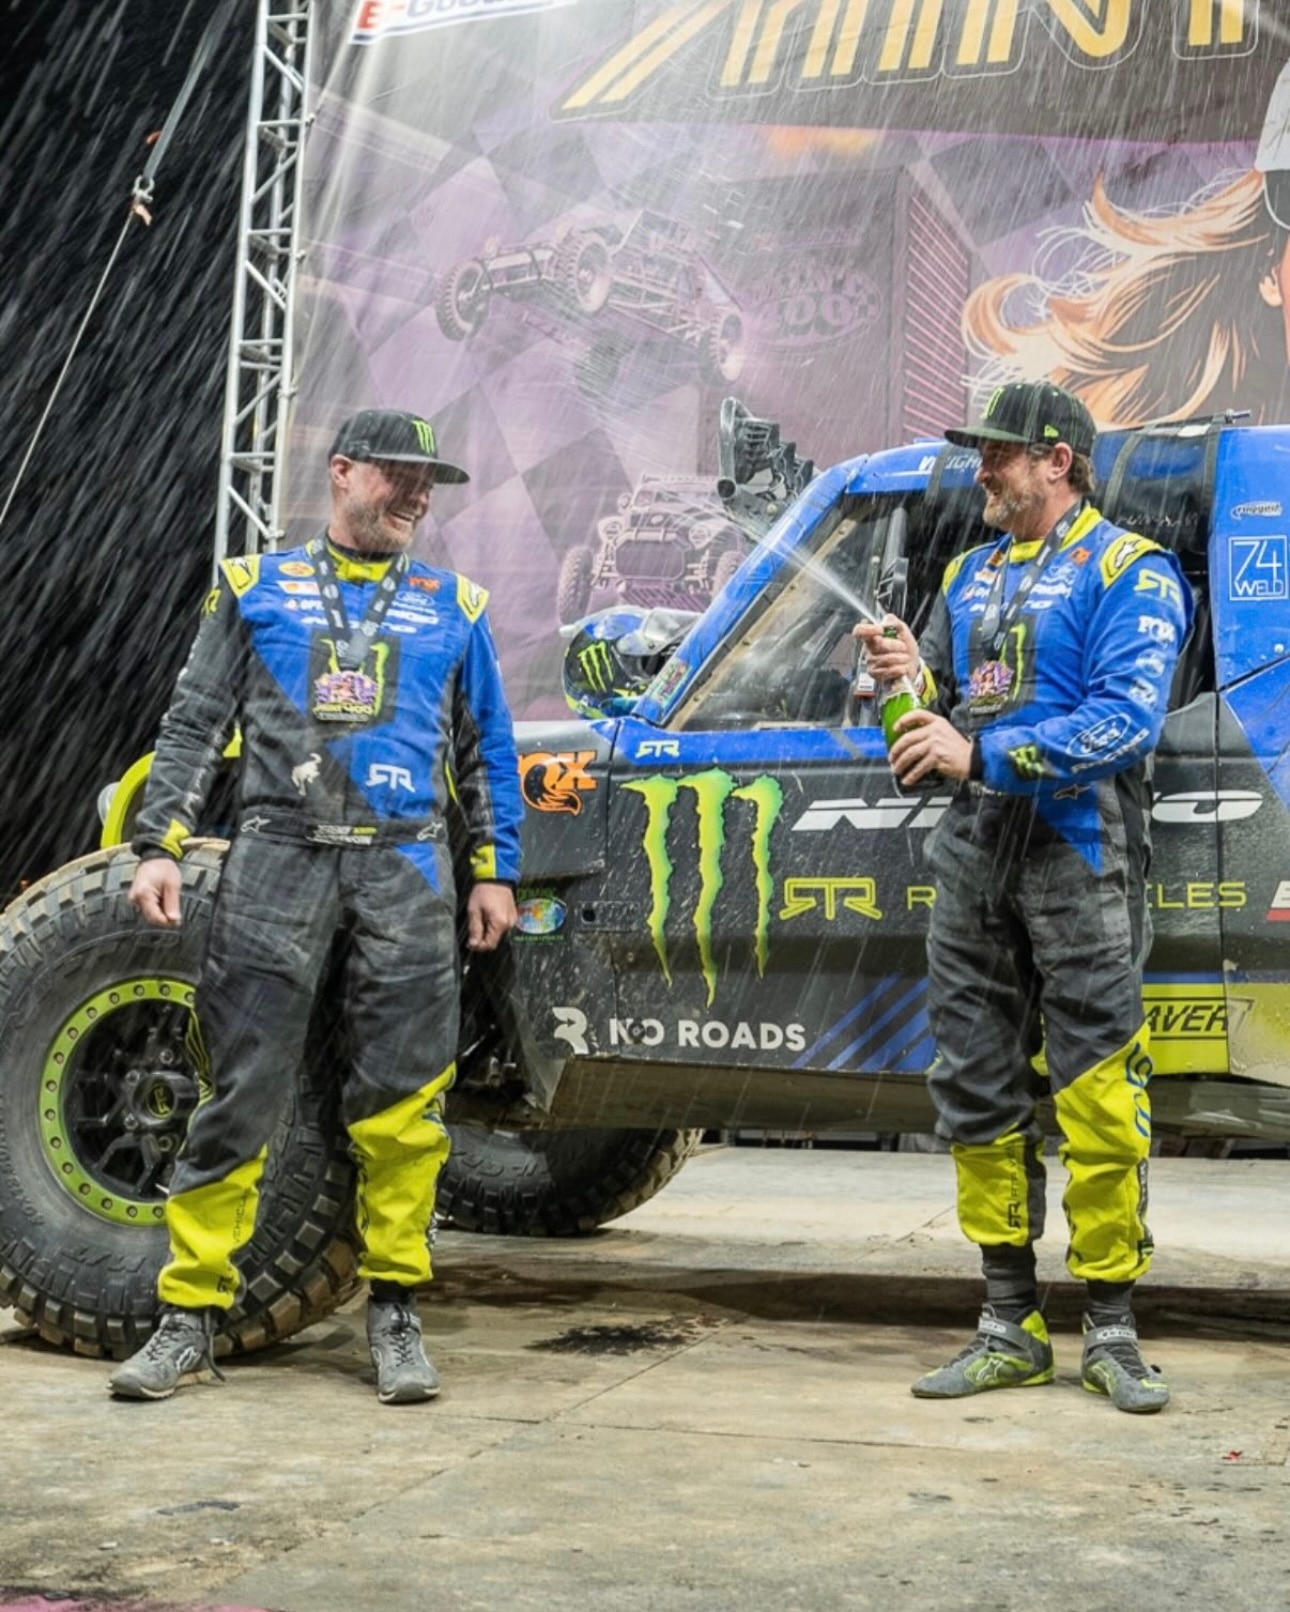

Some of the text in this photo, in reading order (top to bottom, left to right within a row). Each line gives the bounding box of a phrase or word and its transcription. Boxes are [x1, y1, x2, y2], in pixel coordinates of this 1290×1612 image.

[1232, 540, 1284, 584] 74
[1234, 579, 1283, 596] WELD
[634, 740, 680, 758] RTR
[366, 763, 415, 793] RTR
[518, 751, 598, 814] OX
[778, 877, 883, 920] RTR
[677, 1019, 806, 1051] ROADS
